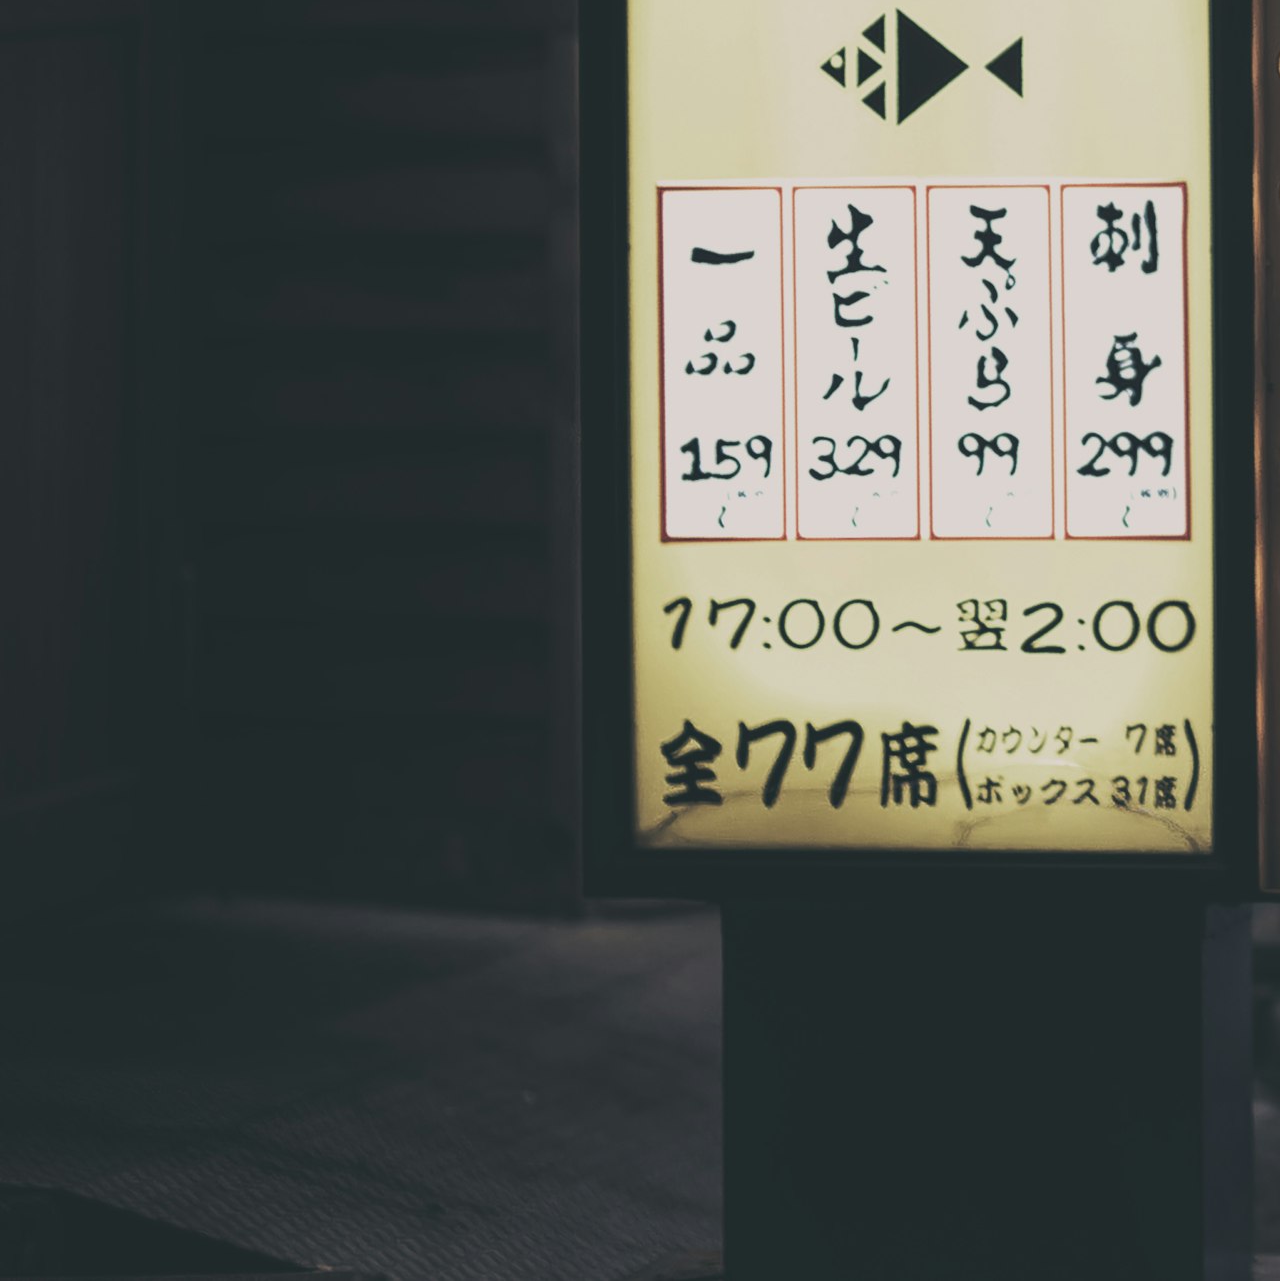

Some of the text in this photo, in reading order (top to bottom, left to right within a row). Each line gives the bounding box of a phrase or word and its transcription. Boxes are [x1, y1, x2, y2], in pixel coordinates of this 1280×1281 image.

[823, 204, 890, 412] 生ビール
[958, 204, 1019, 412] 天ぷら
[1090, 199, 1162, 407] 刺身
[680, 434, 773, 482] 159
[808, 434, 902, 481] 329
[957, 432, 1020, 476] 99
[1076, 431, 1174, 478] 299
[976, 723, 1177, 757] カウンター 7席
[976, 777, 1100, 806] ボックス
